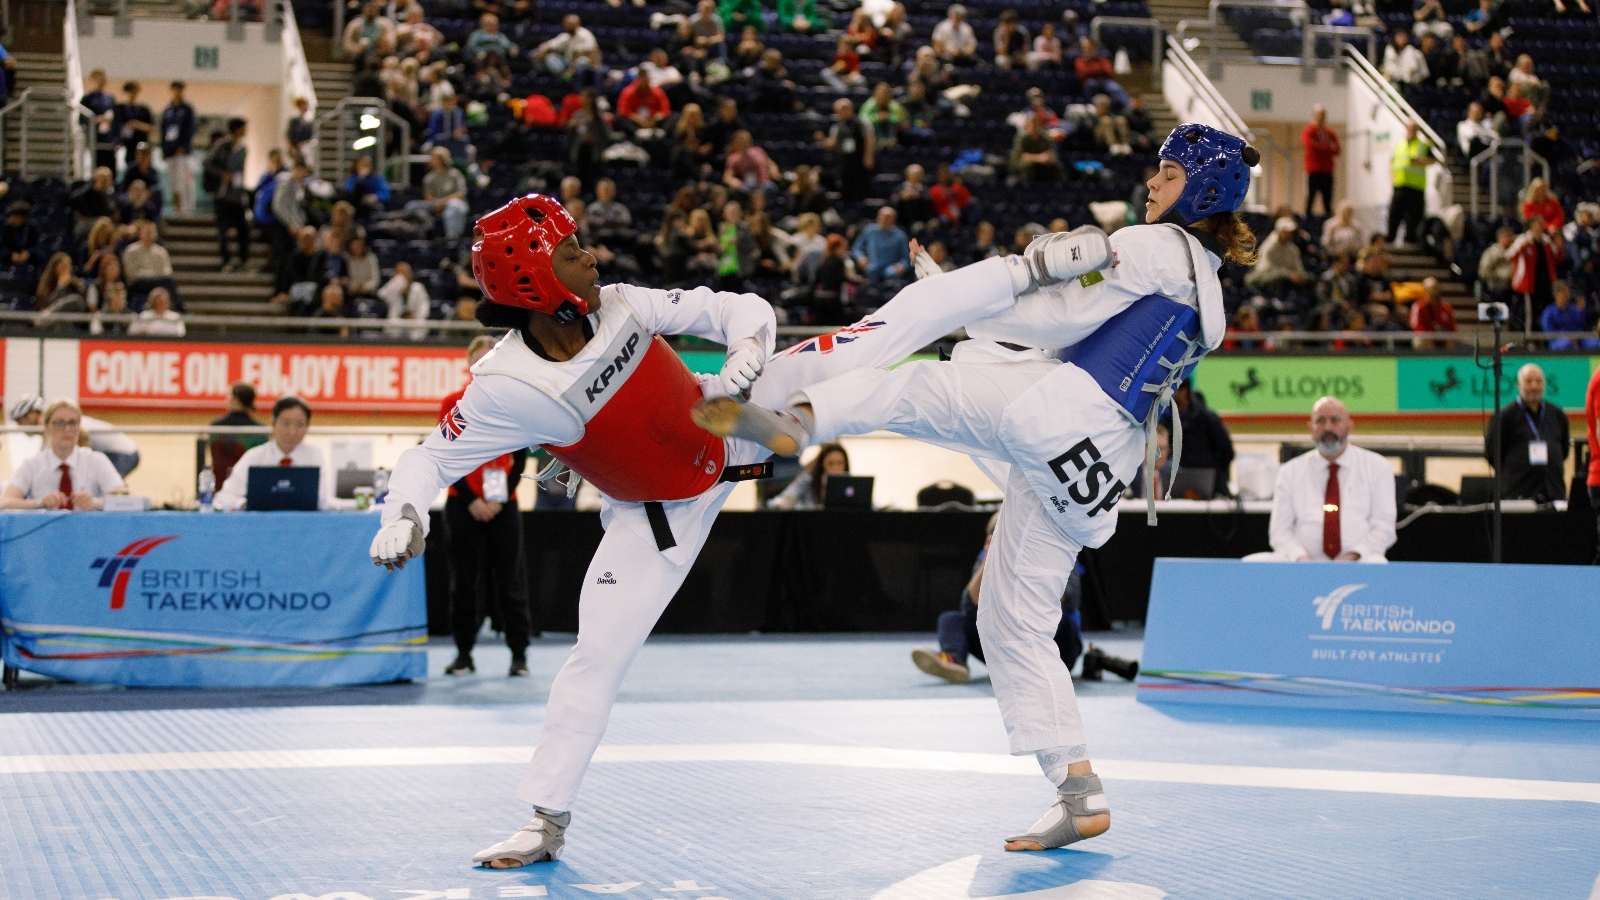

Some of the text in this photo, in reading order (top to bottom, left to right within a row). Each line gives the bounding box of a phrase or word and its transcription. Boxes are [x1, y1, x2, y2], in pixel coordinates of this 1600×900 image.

[1130, 354, 1147, 378] Protector
[1148, 332, 1163, 351] Scoring
[1161, 315, 1176, 332] System
[87, 351, 180, 395] COME
[241, 353, 340, 397] ENJOY
[342, 356, 399, 398] THE
[402, 357, 470, 399] RIDE
[585, 332, 639, 403] KPNP
[1272, 376, 1364, 399] LLOYDS
[141, 569, 261, 588] BRITISH
[141, 592, 331, 611] TAEKWONDO
[1341, 604, 1414, 618] BRITISH
[1341, 618, 1456, 634] TAEKWONDO
[1312, 649, 1442, 664] BUILT FOR ATHLETES
